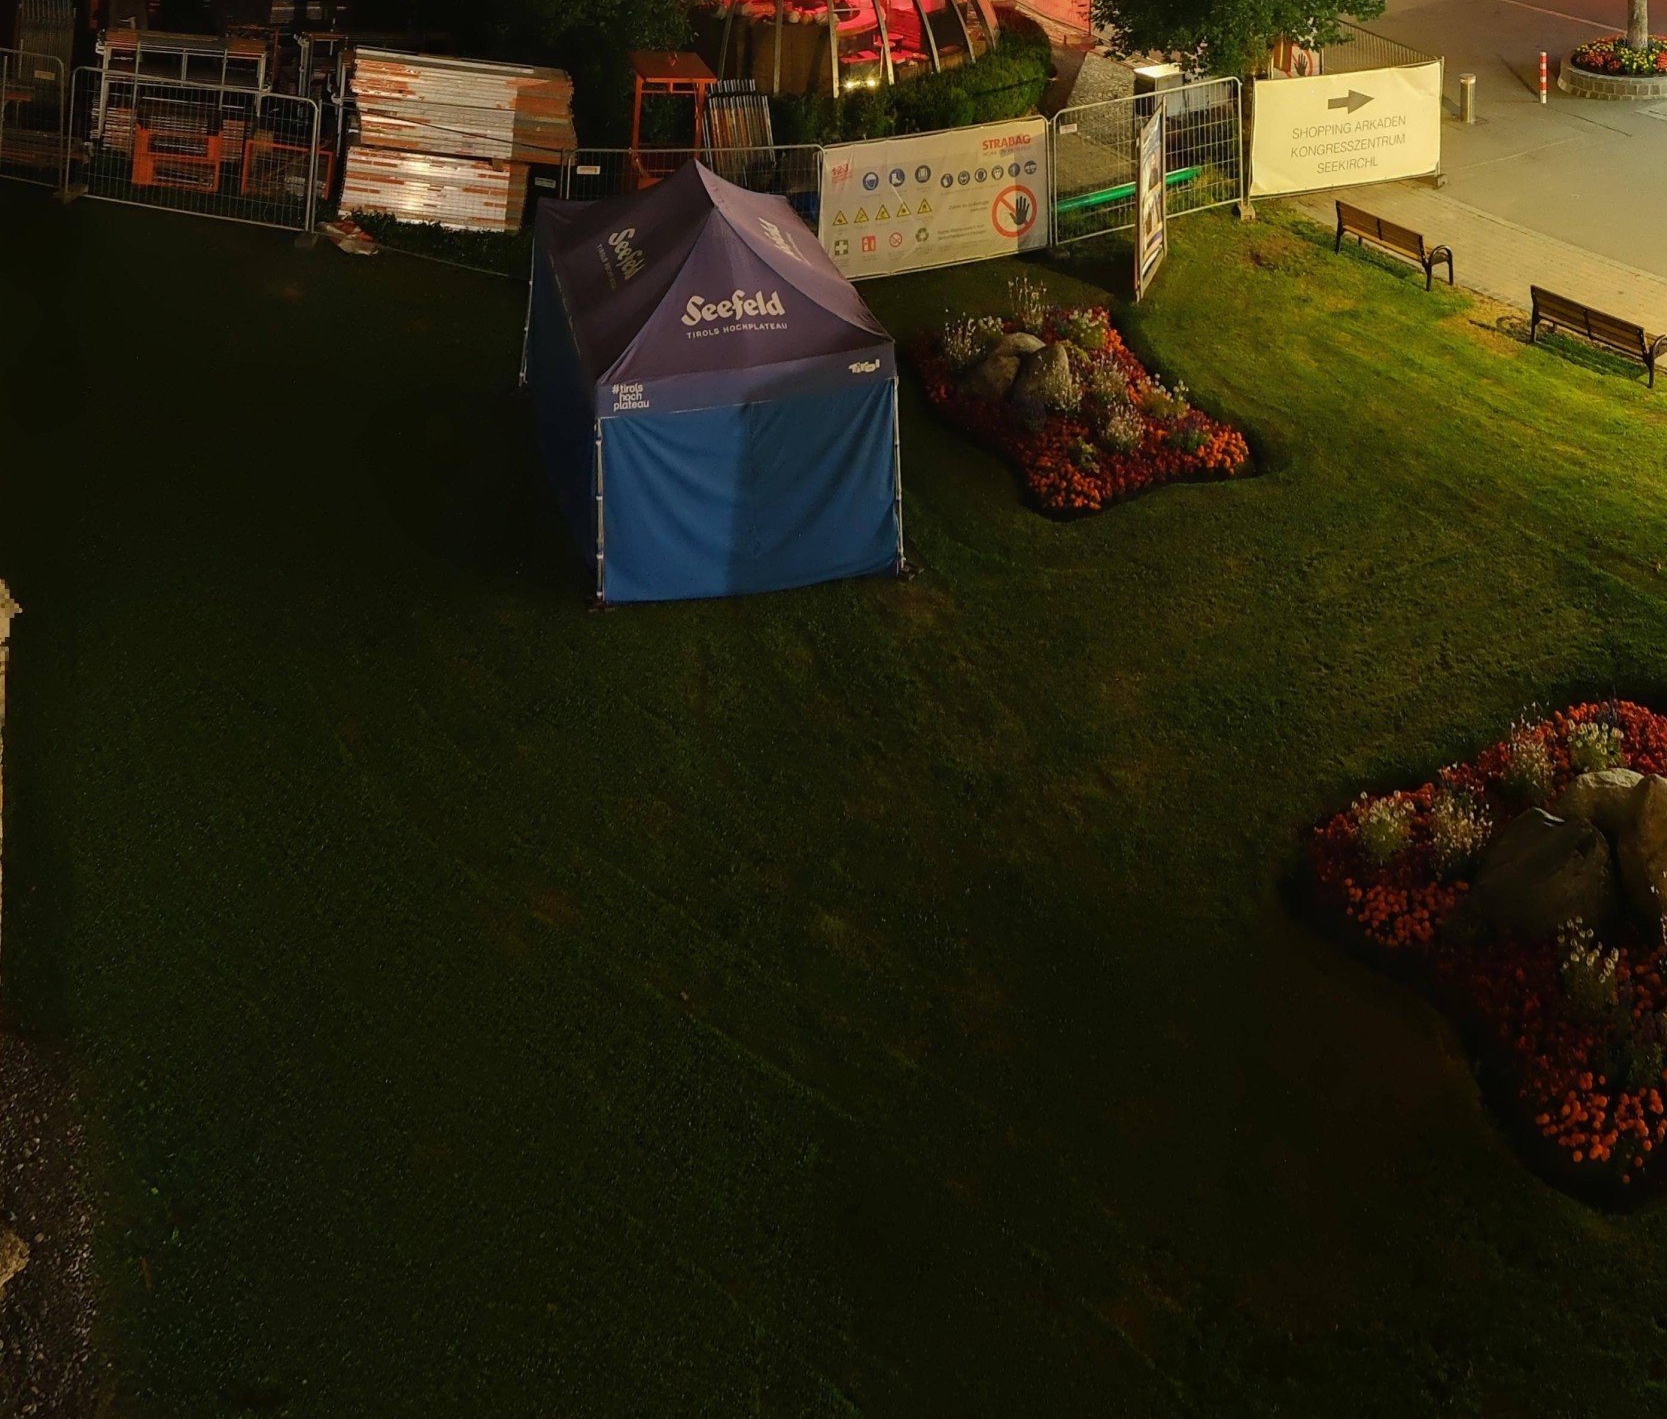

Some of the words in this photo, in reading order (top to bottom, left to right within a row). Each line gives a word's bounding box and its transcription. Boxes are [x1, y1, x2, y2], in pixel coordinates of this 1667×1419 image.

[1292, 123, 1352, 140] SHOPPING
[1354, 115, 1406, 133] ARKADEN
[982, 134, 1032, 151] STRABAG
[1290, 133, 1406, 158] KONGRESSZENTRUM
[1317, 157, 1379, 174] SEEKIRCHL
[608, 227, 646, 281] Seefeld
[681, 289, 786, 326] Seefeld
[686, 327, 720, 339] TIROLS
[723, 322, 788, 333] HOCHPLATEAU
[619, 392, 643, 401] hoch
[613, 399, 650, 412] plateau
